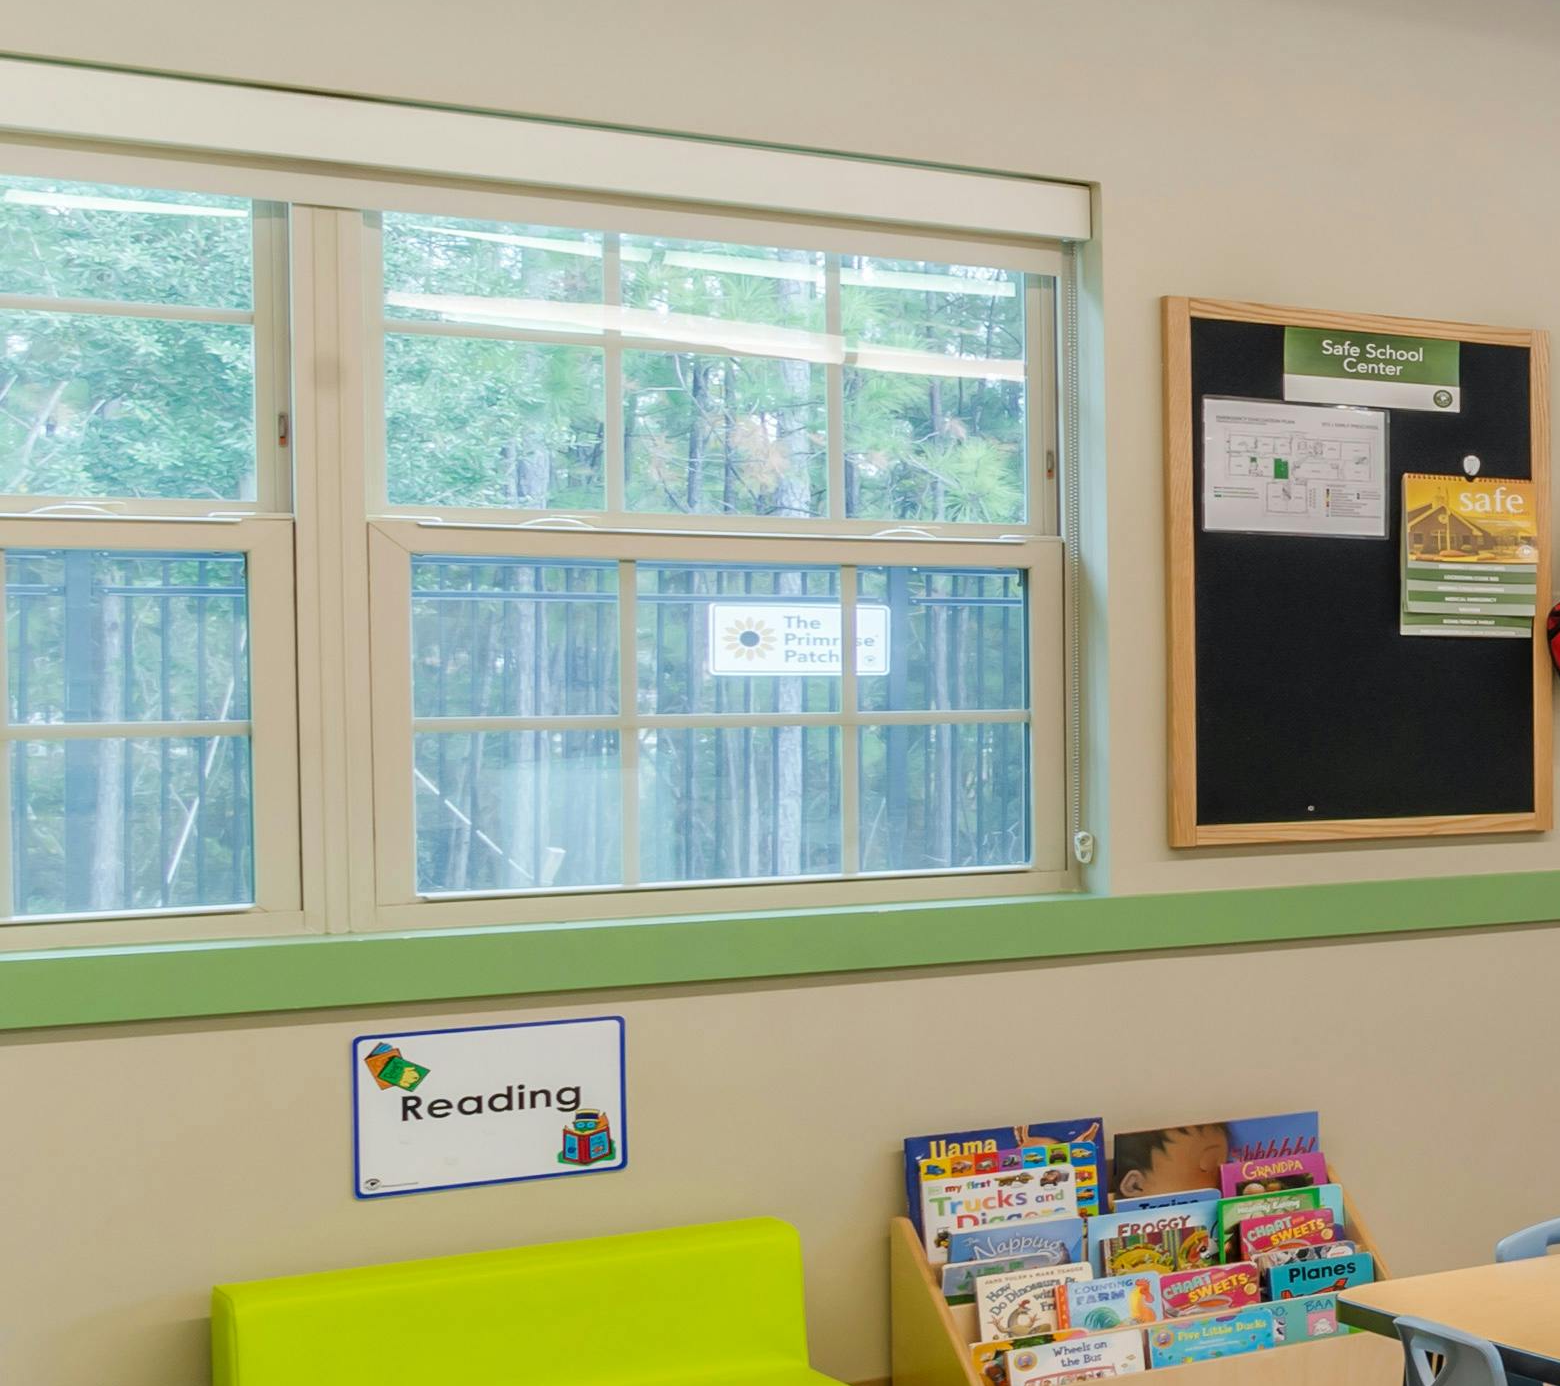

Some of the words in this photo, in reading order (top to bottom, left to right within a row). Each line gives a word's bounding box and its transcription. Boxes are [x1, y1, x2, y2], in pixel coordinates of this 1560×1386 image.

[1322, 340, 1361, 357] Safe
[1366, 344, 1424, 362] School
[1343, 358, 1403, 376] Center
[1459, 486, 1525, 514] safe
[783, 616, 821, 630] The
[784, 633, 875, 647] Primrse
[784, 649, 840, 663] Patch
[400, 1084, 582, 1123] Reading
[929, 1139, 997, 1161] llama
[1242, 1160, 1304, 1180] GRANDPA
[944, 1184, 962, 1193] my
[966, 1179, 991, 1190] first
[929, 1190, 1027, 1217] Trucks
[1035, 1190, 1064, 1203] and
[1118, 1215, 1191, 1237] FROGGY
[1270, 1218, 1326, 1246] SWEETS
[973, 1236, 1062, 1264] Napping
[1289, 1262, 1356, 1283] Planes
[986, 1283, 1011, 1303] How
[1074, 1278, 1134, 1295] COUNTING
[1188, 1273, 1249, 1303] SWEETS
[990, 1302, 1008, 1317] Do
[1005, 1278, 1060, 1301] Dinosaurs
[1076, 1289, 1126, 1306] FARM
[1304, 1299, 1334, 1313] BAA
[1177, 1331, 1200, 1341] Five
[1202, 1326, 1233, 1337] Little
[1236, 1319, 1266, 1331] Ducks
[1052, 1342, 1090, 1357] Wheels
[1094, 1341, 1107, 1349] on
[1060, 1358, 1080, 1367] the
[1083, 1353, 1102, 1363] Bus
